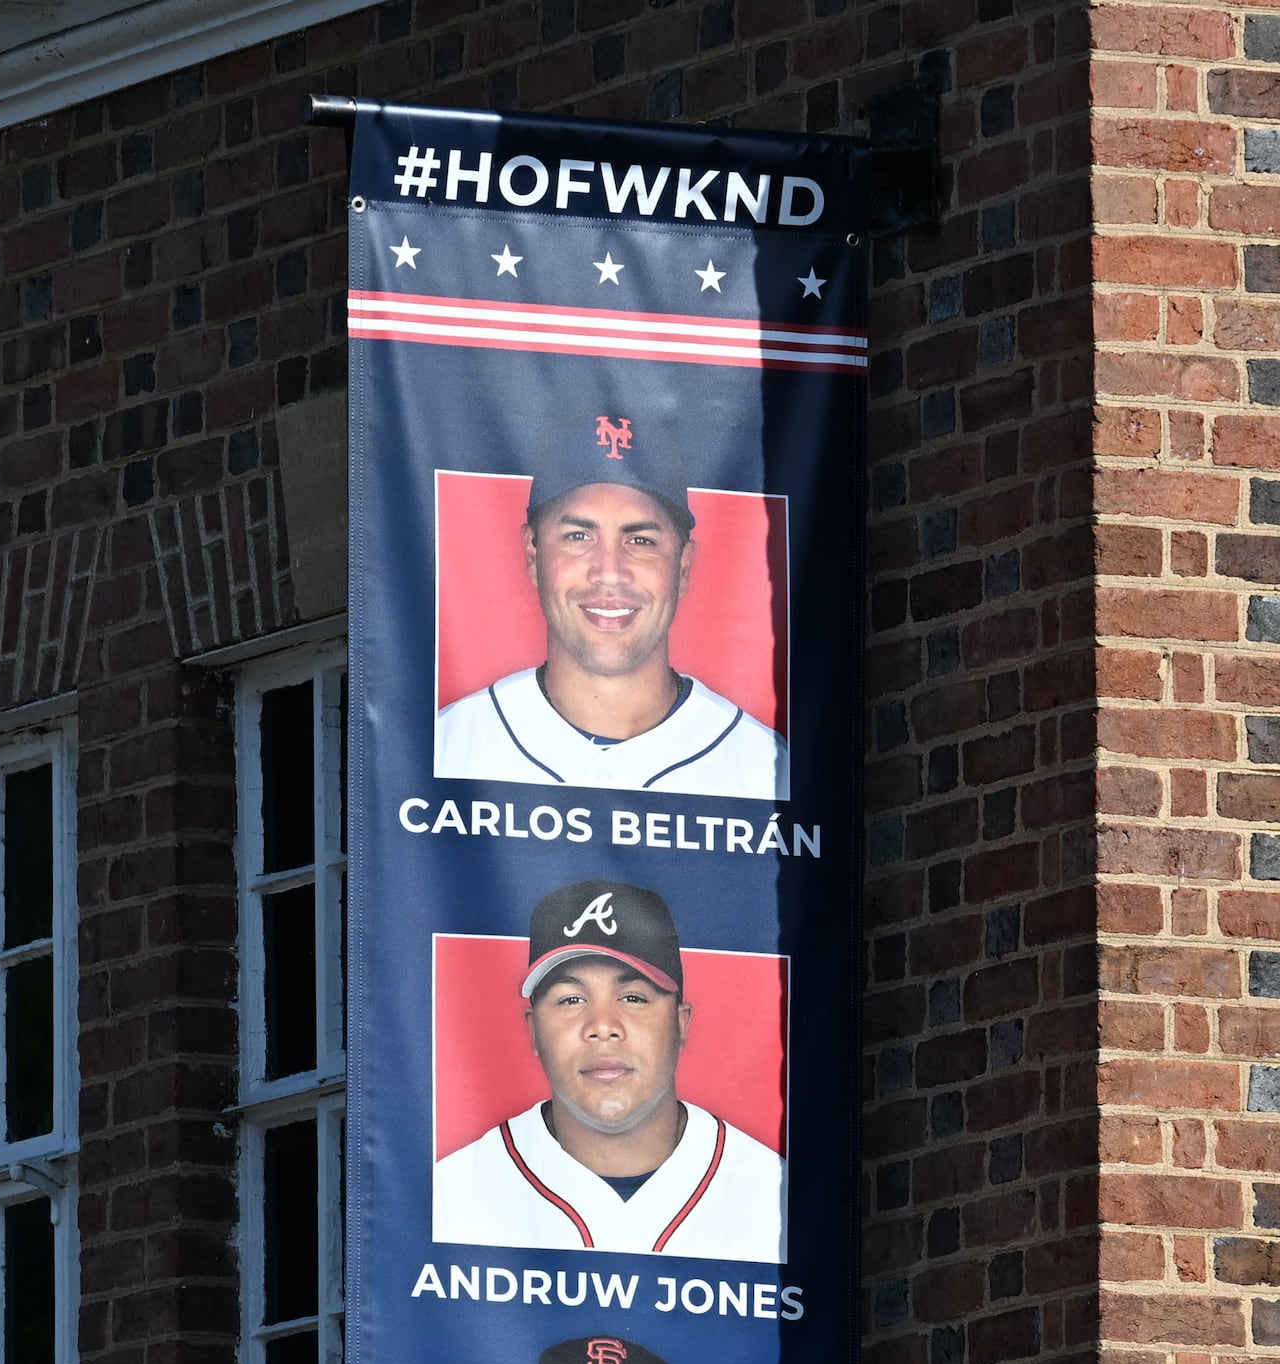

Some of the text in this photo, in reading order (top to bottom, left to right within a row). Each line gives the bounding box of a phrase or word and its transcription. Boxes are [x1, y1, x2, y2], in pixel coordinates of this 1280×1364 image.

[394, 146, 825, 226] #HOFWKND
[398, 797, 821, 858] CARLOS BELTRÁN
[411, 1263, 805, 1321] ANDRUW JONES
